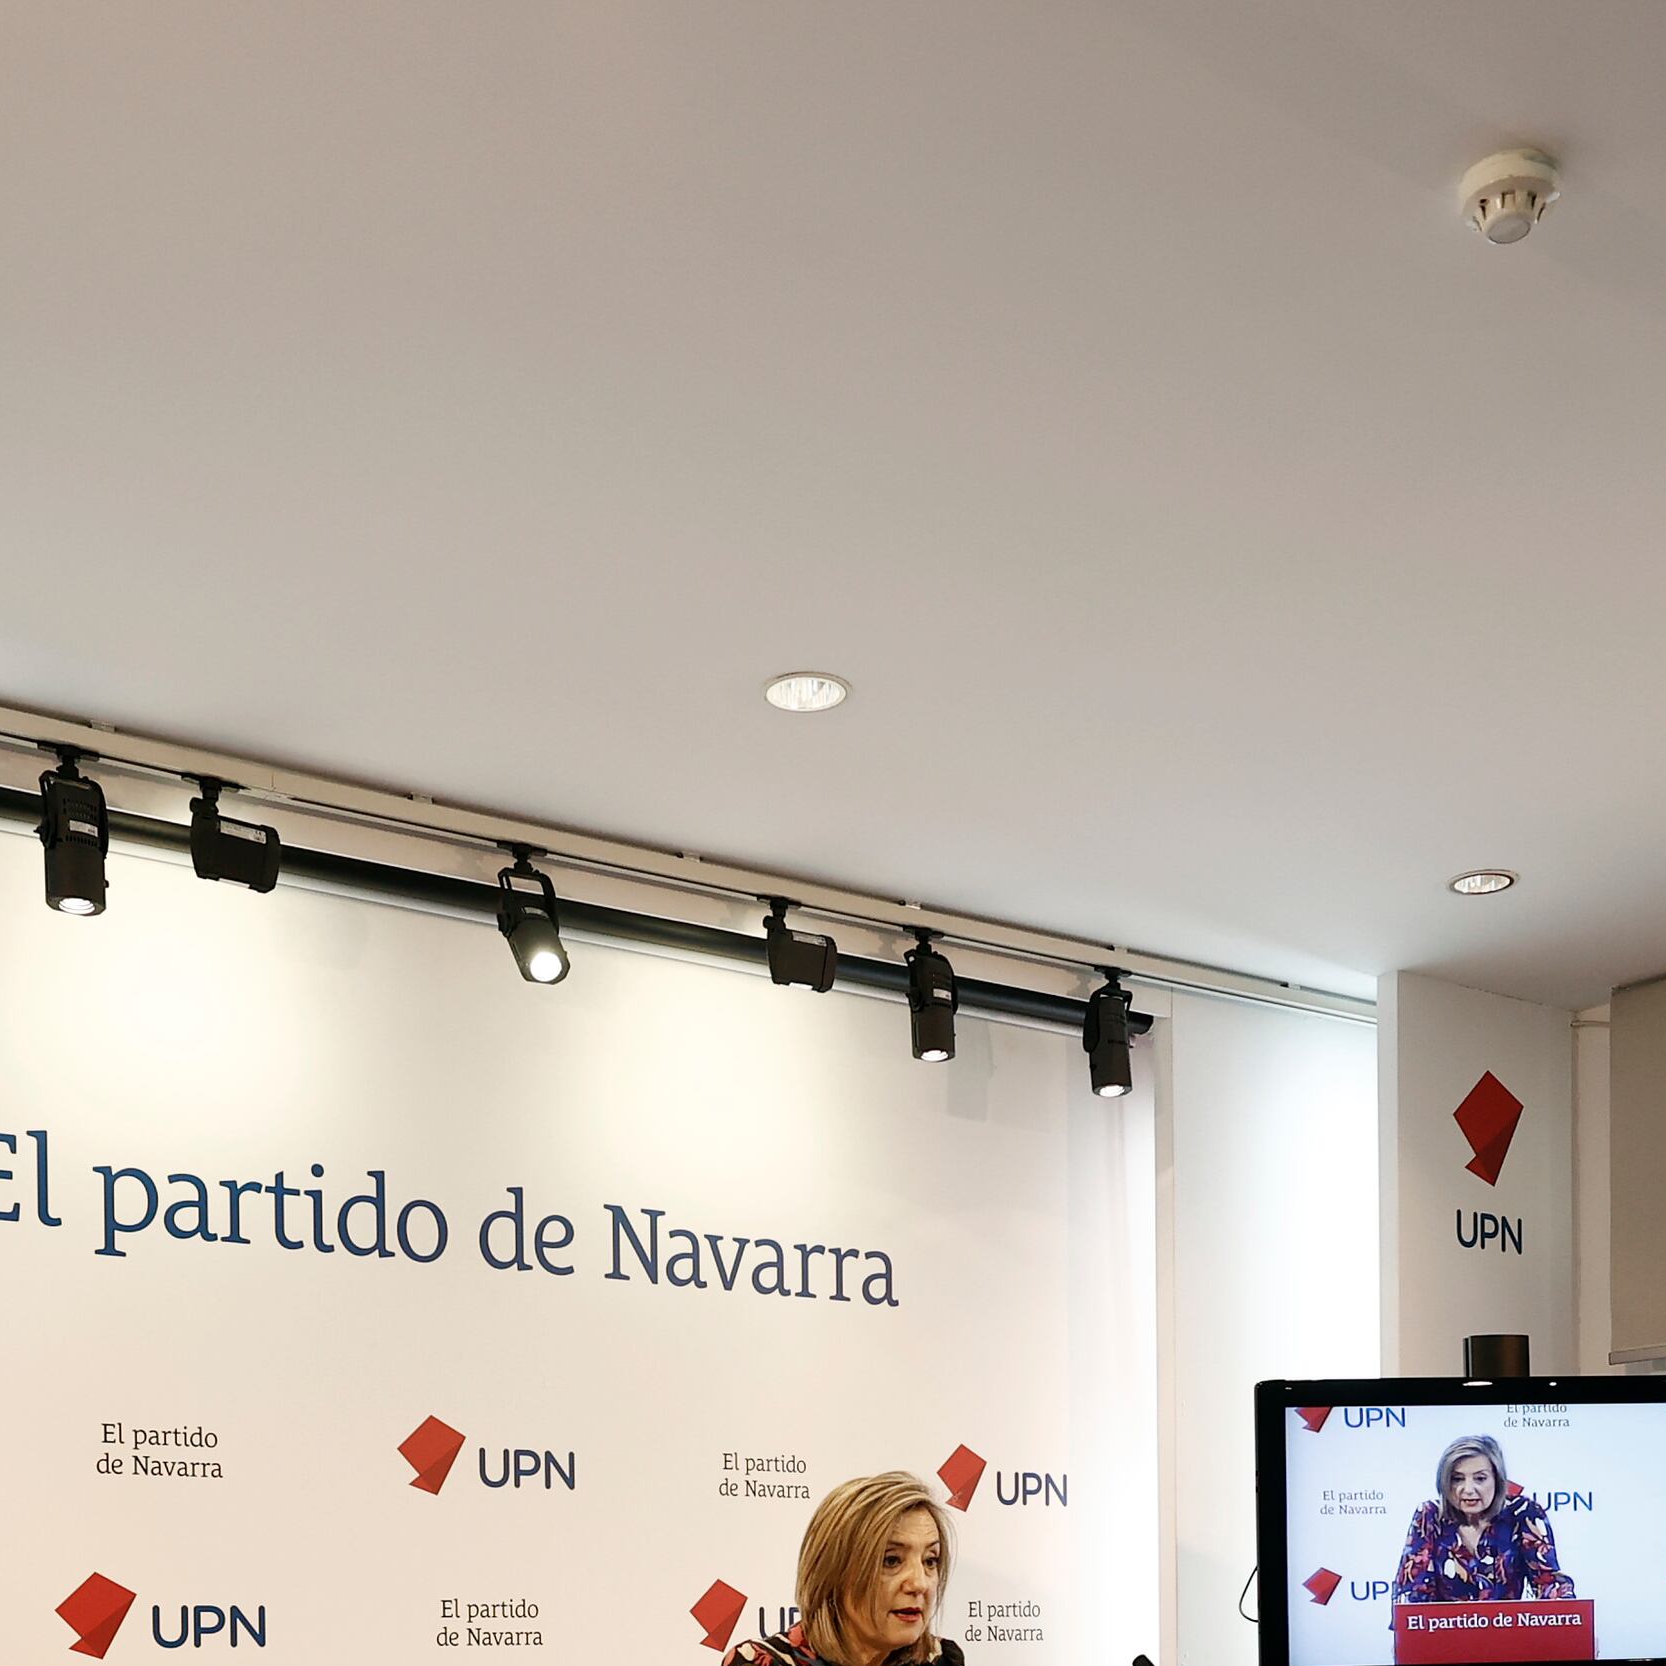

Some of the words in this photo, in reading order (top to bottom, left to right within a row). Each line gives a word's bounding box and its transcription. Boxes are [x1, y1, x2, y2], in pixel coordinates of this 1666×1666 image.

[93, 1164, 448, 1263] partido
[479, 1187, 574, 1275] de
[604, 1204, 899, 1307] Navarra
[1457, 1209, 1522, 1254] UPN
[1344, 1408, 1405, 1427] UPN
[1504, 1417, 1517, 1427] de
[1523, 1418, 1569, 1427] Navarra
[101, 1423, 125, 1444] El
[133, 1426, 217, 1450] partido
[97, 1453, 123, 1474] de
[132, 1456, 223, 1478] Navarra
[479, 1448, 575, 1490] UPN
[723, 1452, 739, 1470] El
[745, 1455, 806, 1475] partido
[719, 1478, 738, 1496] de
[745, 1480, 810, 1499] Navarra
[997, 1471, 1067, 1506] UPN
[1323, 1490, 1334, 1500] El
[1339, 1490, 1383, 1503] partido
[1320, 1505, 1334, 1514] de
[1339, 1505, 1386, 1514] Navarra
[1533, 1492, 1593, 1512] UPN
[1351, 1581, 1397, 1600] UP
[440, 1599, 461, 1619] El
[467, 1599, 538, 1623] partido
[969, 1601, 982, 1617] El
[987, 1601, 1040, 1621] partido
[152, 1605, 266, 1648] UPN
[1408, 1615, 1424, 1629] El
[1428, 1614, 1488, 1632] partido
[1493, 1613, 1512, 1627] de
[1517, 1613, 1581, 1626] Navarra
[437, 1627, 458, 1646] de
[467, 1628, 543, 1646] Navarra
[965, 1625, 981, 1641] de
[987, 1626, 1043, 1641] Navarra
